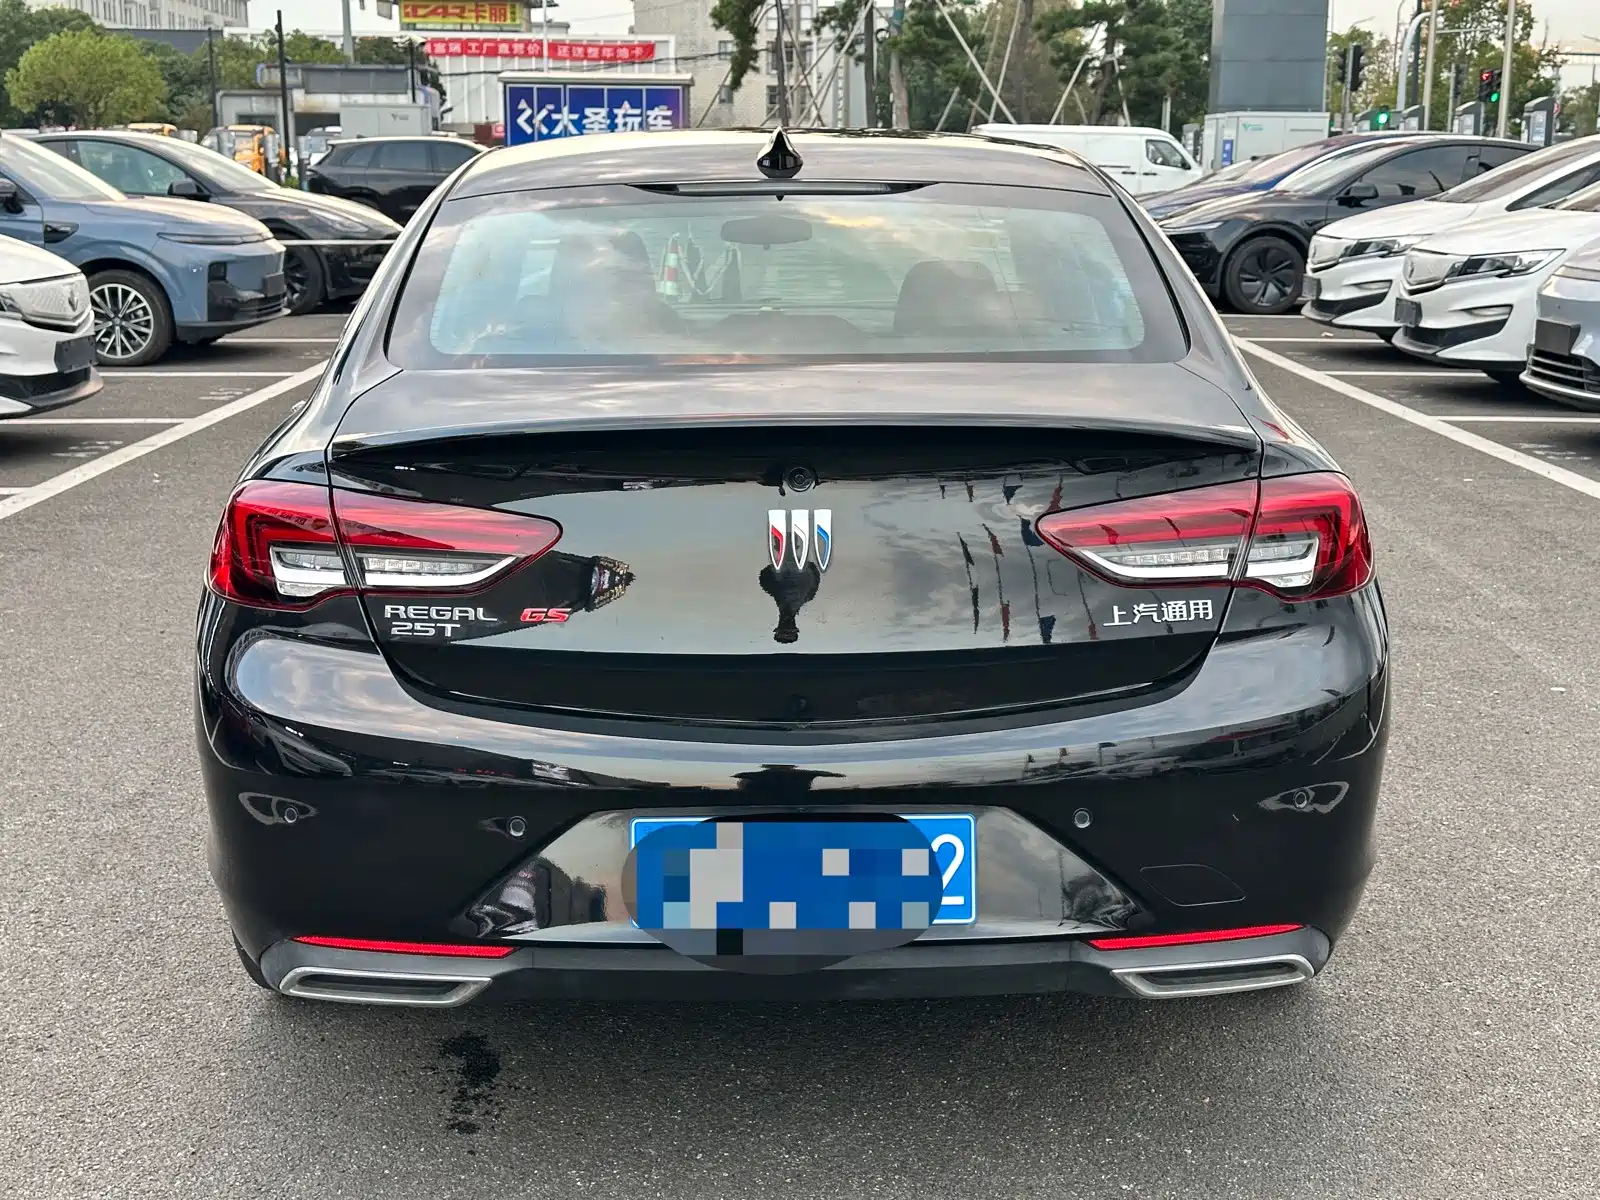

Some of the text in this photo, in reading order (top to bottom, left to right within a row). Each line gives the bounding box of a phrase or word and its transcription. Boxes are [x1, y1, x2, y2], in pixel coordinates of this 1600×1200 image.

[384, 605, 571, 623] REGAL GS
[1103, 599, 1213, 627] 上汽通用
[390, 622, 461, 637] 25T
